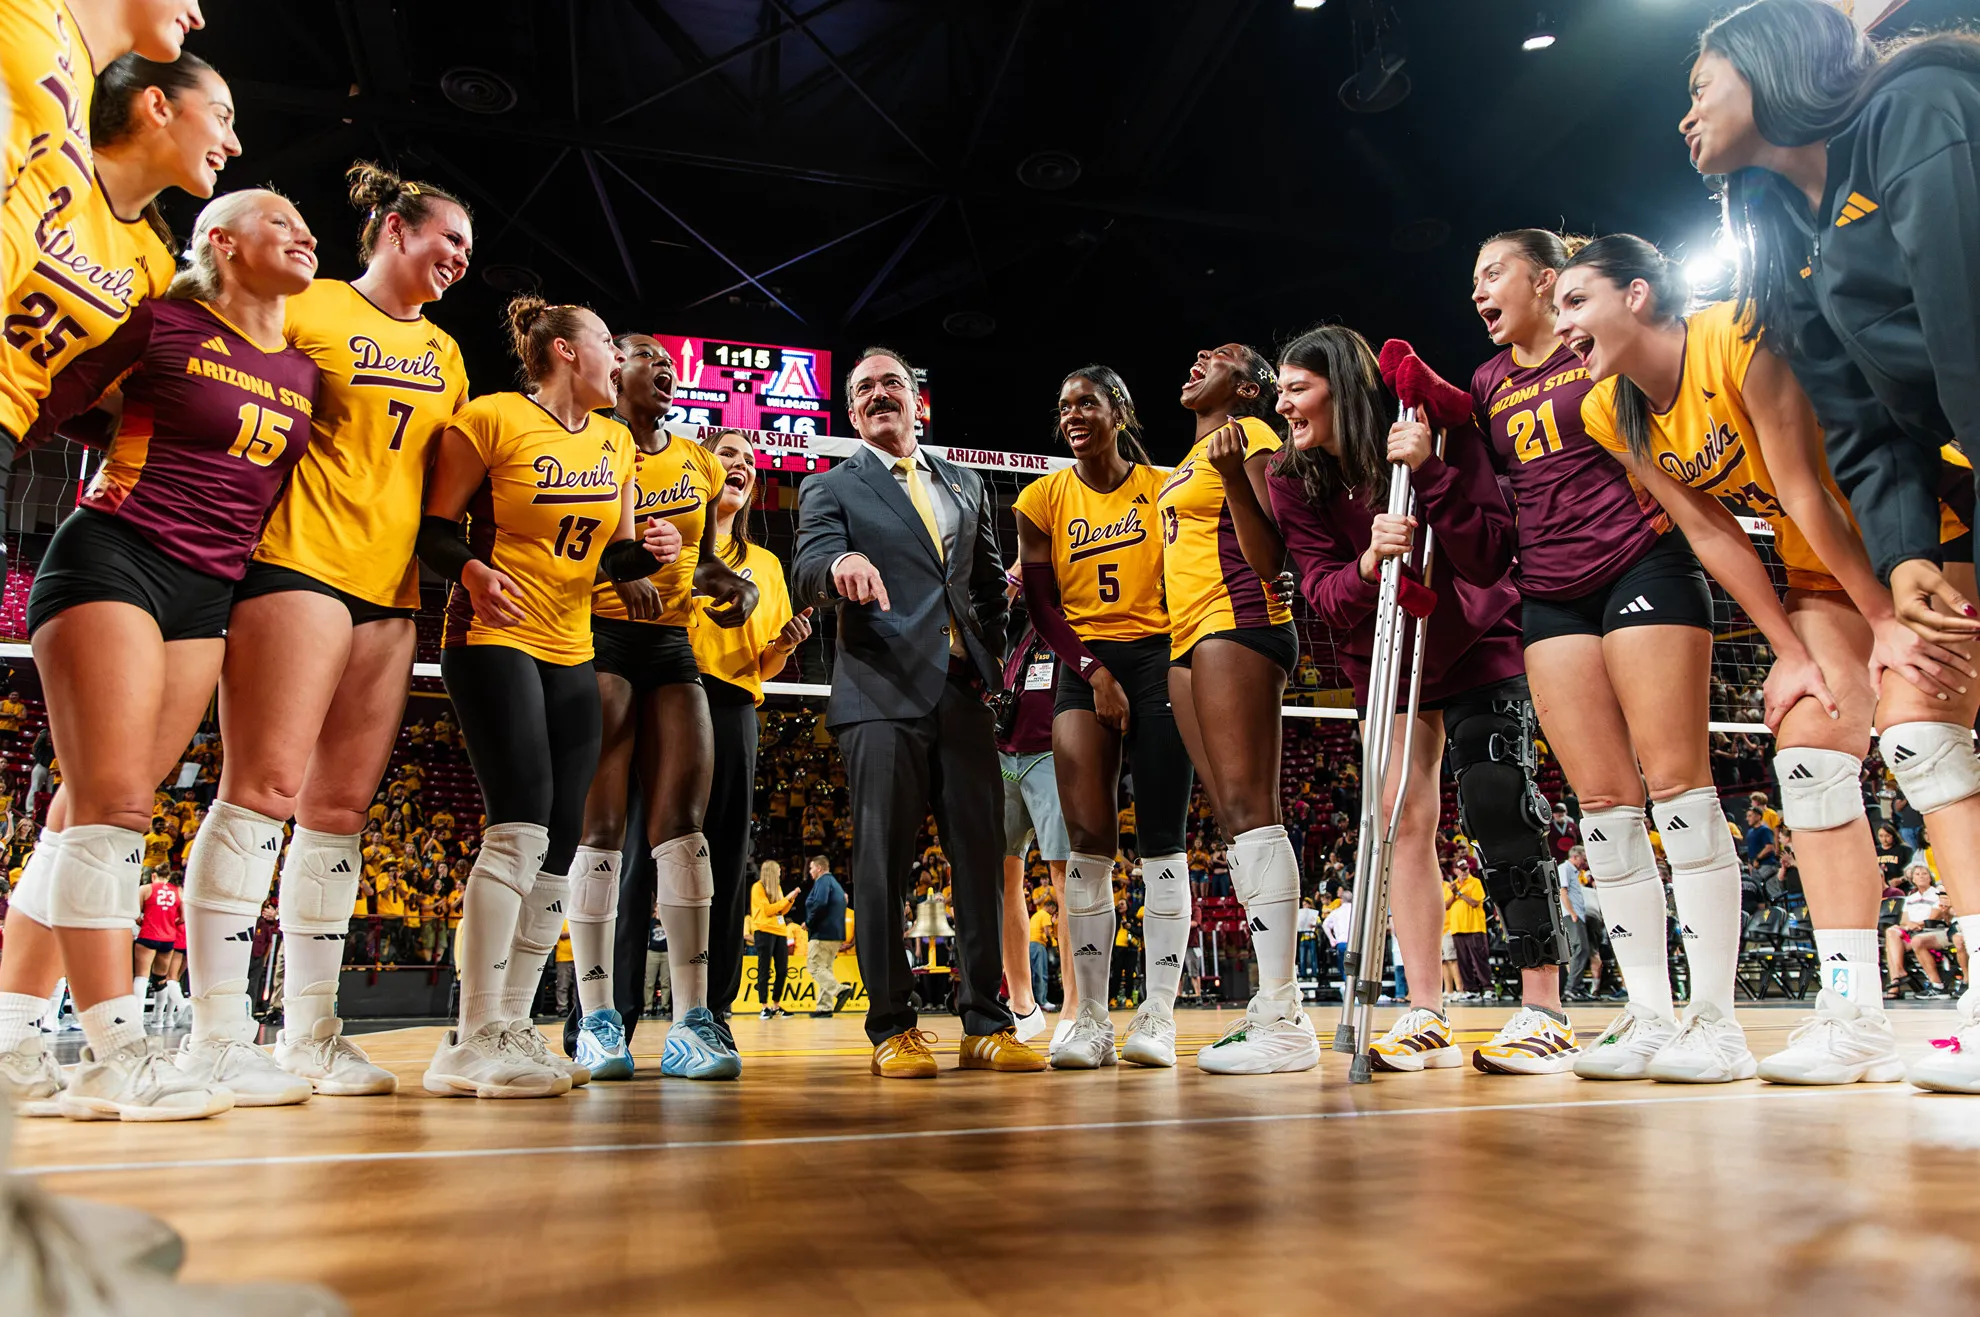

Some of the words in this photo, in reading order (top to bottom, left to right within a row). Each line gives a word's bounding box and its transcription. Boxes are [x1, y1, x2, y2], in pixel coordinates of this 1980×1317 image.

[43, 228, 135, 306] Devils
[3, 291, 90, 370] 25
[348, 335, 444, 380] Devils
[715, 345, 770, 369] 1:15
[186, 357, 277, 400] ARIZONA
[279, 387, 313, 418] STATE
[737, 383, 746, 392] 4
[227, 402, 294, 467] 15
[387, 398, 415, 451] 7
[664, 406, 710, 427] 25
[773, 415, 817, 437] 16
[1506, 398, 1564, 465] 21
[765, 430, 810, 449] STATE
[946, 448, 1005, 466] ARIZONA
[1009, 453, 1049, 470] STATE
[1658, 411, 1741, 486] Devils
[533, 455, 618, 493] Devils
[772, 457, 781, 468] 1
[552, 514, 602, 562] 13
[1067, 507, 1147, 551] Devils
[1097, 563, 1121, 604] 5
[156, 889, 176, 907] 23
[581, 972, 609, 982] adidas
